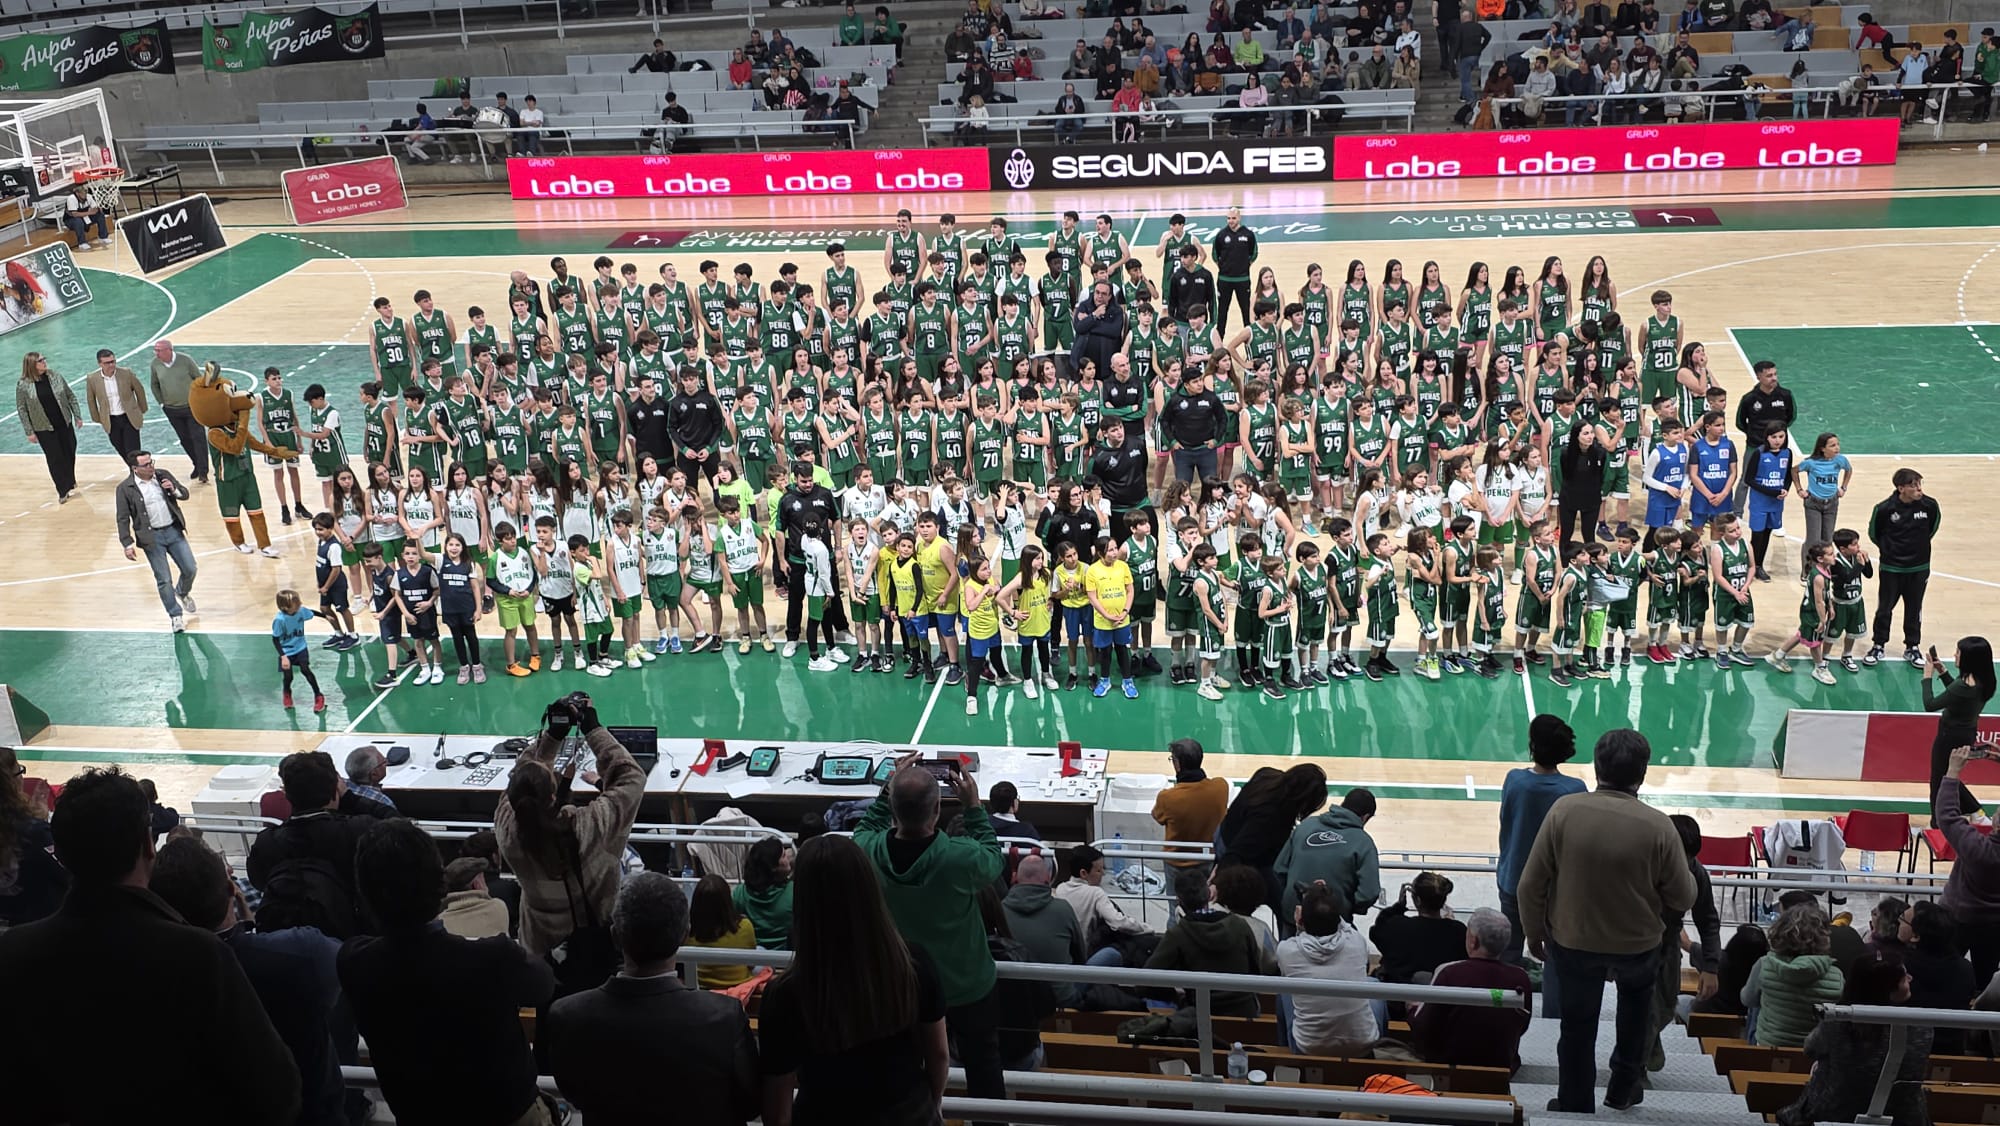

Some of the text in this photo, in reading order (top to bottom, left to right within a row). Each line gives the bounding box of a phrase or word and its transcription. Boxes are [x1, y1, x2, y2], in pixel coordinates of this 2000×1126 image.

[245, 16, 295, 48] Aupa
[268, 24, 333, 60] Peñas
[21, 36, 76, 71] Aupa
[53, 41, 119, 82] Peñas
[1626, 129, 1659, 139] GRUPO
[1762, 125, 1795, 135] GRUPO
[1366, 138, 1397, 148] GRUPO
[1499, 134, 1531, 143] GRUPO
[643, 156, 670, 166] GRUPO
[764, 153, 791, 163] GRUPO
[874, 151, 903, 160] GRUPO
[1624, 146, 1726, 172] Lobe
[1758, 143, 1863, 167] Lobe
[528, 158, 555, 168] GRUPO
[1052, 146, 1327, 181] SEGUNDA FEB
[1365, 154, 1461, 179] Lobe
[1497, 151, 1597, 175] Lobe
[307, 173, 330, 182] GRUPO
[645, 172, 731, 195] Lobe
[765, 170, 852, 193] Lobe
[876, 168, 964, 190] Lobe
[531, 175, 614, 196] Lobe
[311, 182, 381, 204] Lobe
[338, 204, 358, 213] QUALITY
[360, 201, 377, 209] HOMES
[1389, 210, 1630, 224] Ayuntamiento
[1448, 219, 1636, 232] de Huesca
[689, 229, 897, 240] Ayuntamiento
[680, 237, 846, 247] de Huesca
[995, 265, 1005, 277] 10
[1053, 304, 1060, 317] 7
[1308, 312, 1322, 323] 48
[1552, 307, 1559, 316] 6
[1586, 309, 1599, 321] 00
[709, 312, 723, 325] 32
[1477, 315, 1488, 328] 16
[431, 341, 440, 355] 6
[569, 336, 586, 350] 34
[661, 337, 670, 350] 7
[772, 334, 788, 348] 88
[809, 339, 822, 353] 18
[927, 334, 934, 348] 8
[386, 347, 403, 363] 30
[522, 345, 531, 359] 5
[886, 344, 893, 356] 2
[1602, 354, 1611, 367] 11
[1655, 352, 1672, 367] 20
[1138, 362, 1149, 376] 17
[1426, 404, 1433, 416] 3
[1541, 400, 1554, 413] 18
[1084, 411, 1097, 424] 23
[1623, 410, 1637, 422] 28
[465, 431, 481, 447] 18
[741, 428, 765, 437] PEÑAS
[368, 436, 380, 451] 41
[501, 439, 517, 455] 14
[749, 442, 759, 456] 4
[835, 443, 849, 458] 10
[1020, 443, 1034, 458] 31
[1257, 442, 1272, 457] 70
[1324, 437, 1342, 453] 99
[911, 444, 918, 458] 9
[946, 444, 961, 458] 60
[1406, 447, 1422, 462] 77
[983, 453, 998, 468] 70
[1293, 454, 1305, 468] 12
[1487, 488, 1510, 497] PEÑAS
[1347, 581, 1356, 596] 17
[1666, 584, 1673, 596] 9
[1317, 600, 1324, 614] 7
[1496, 606, 1503, 619] 2
